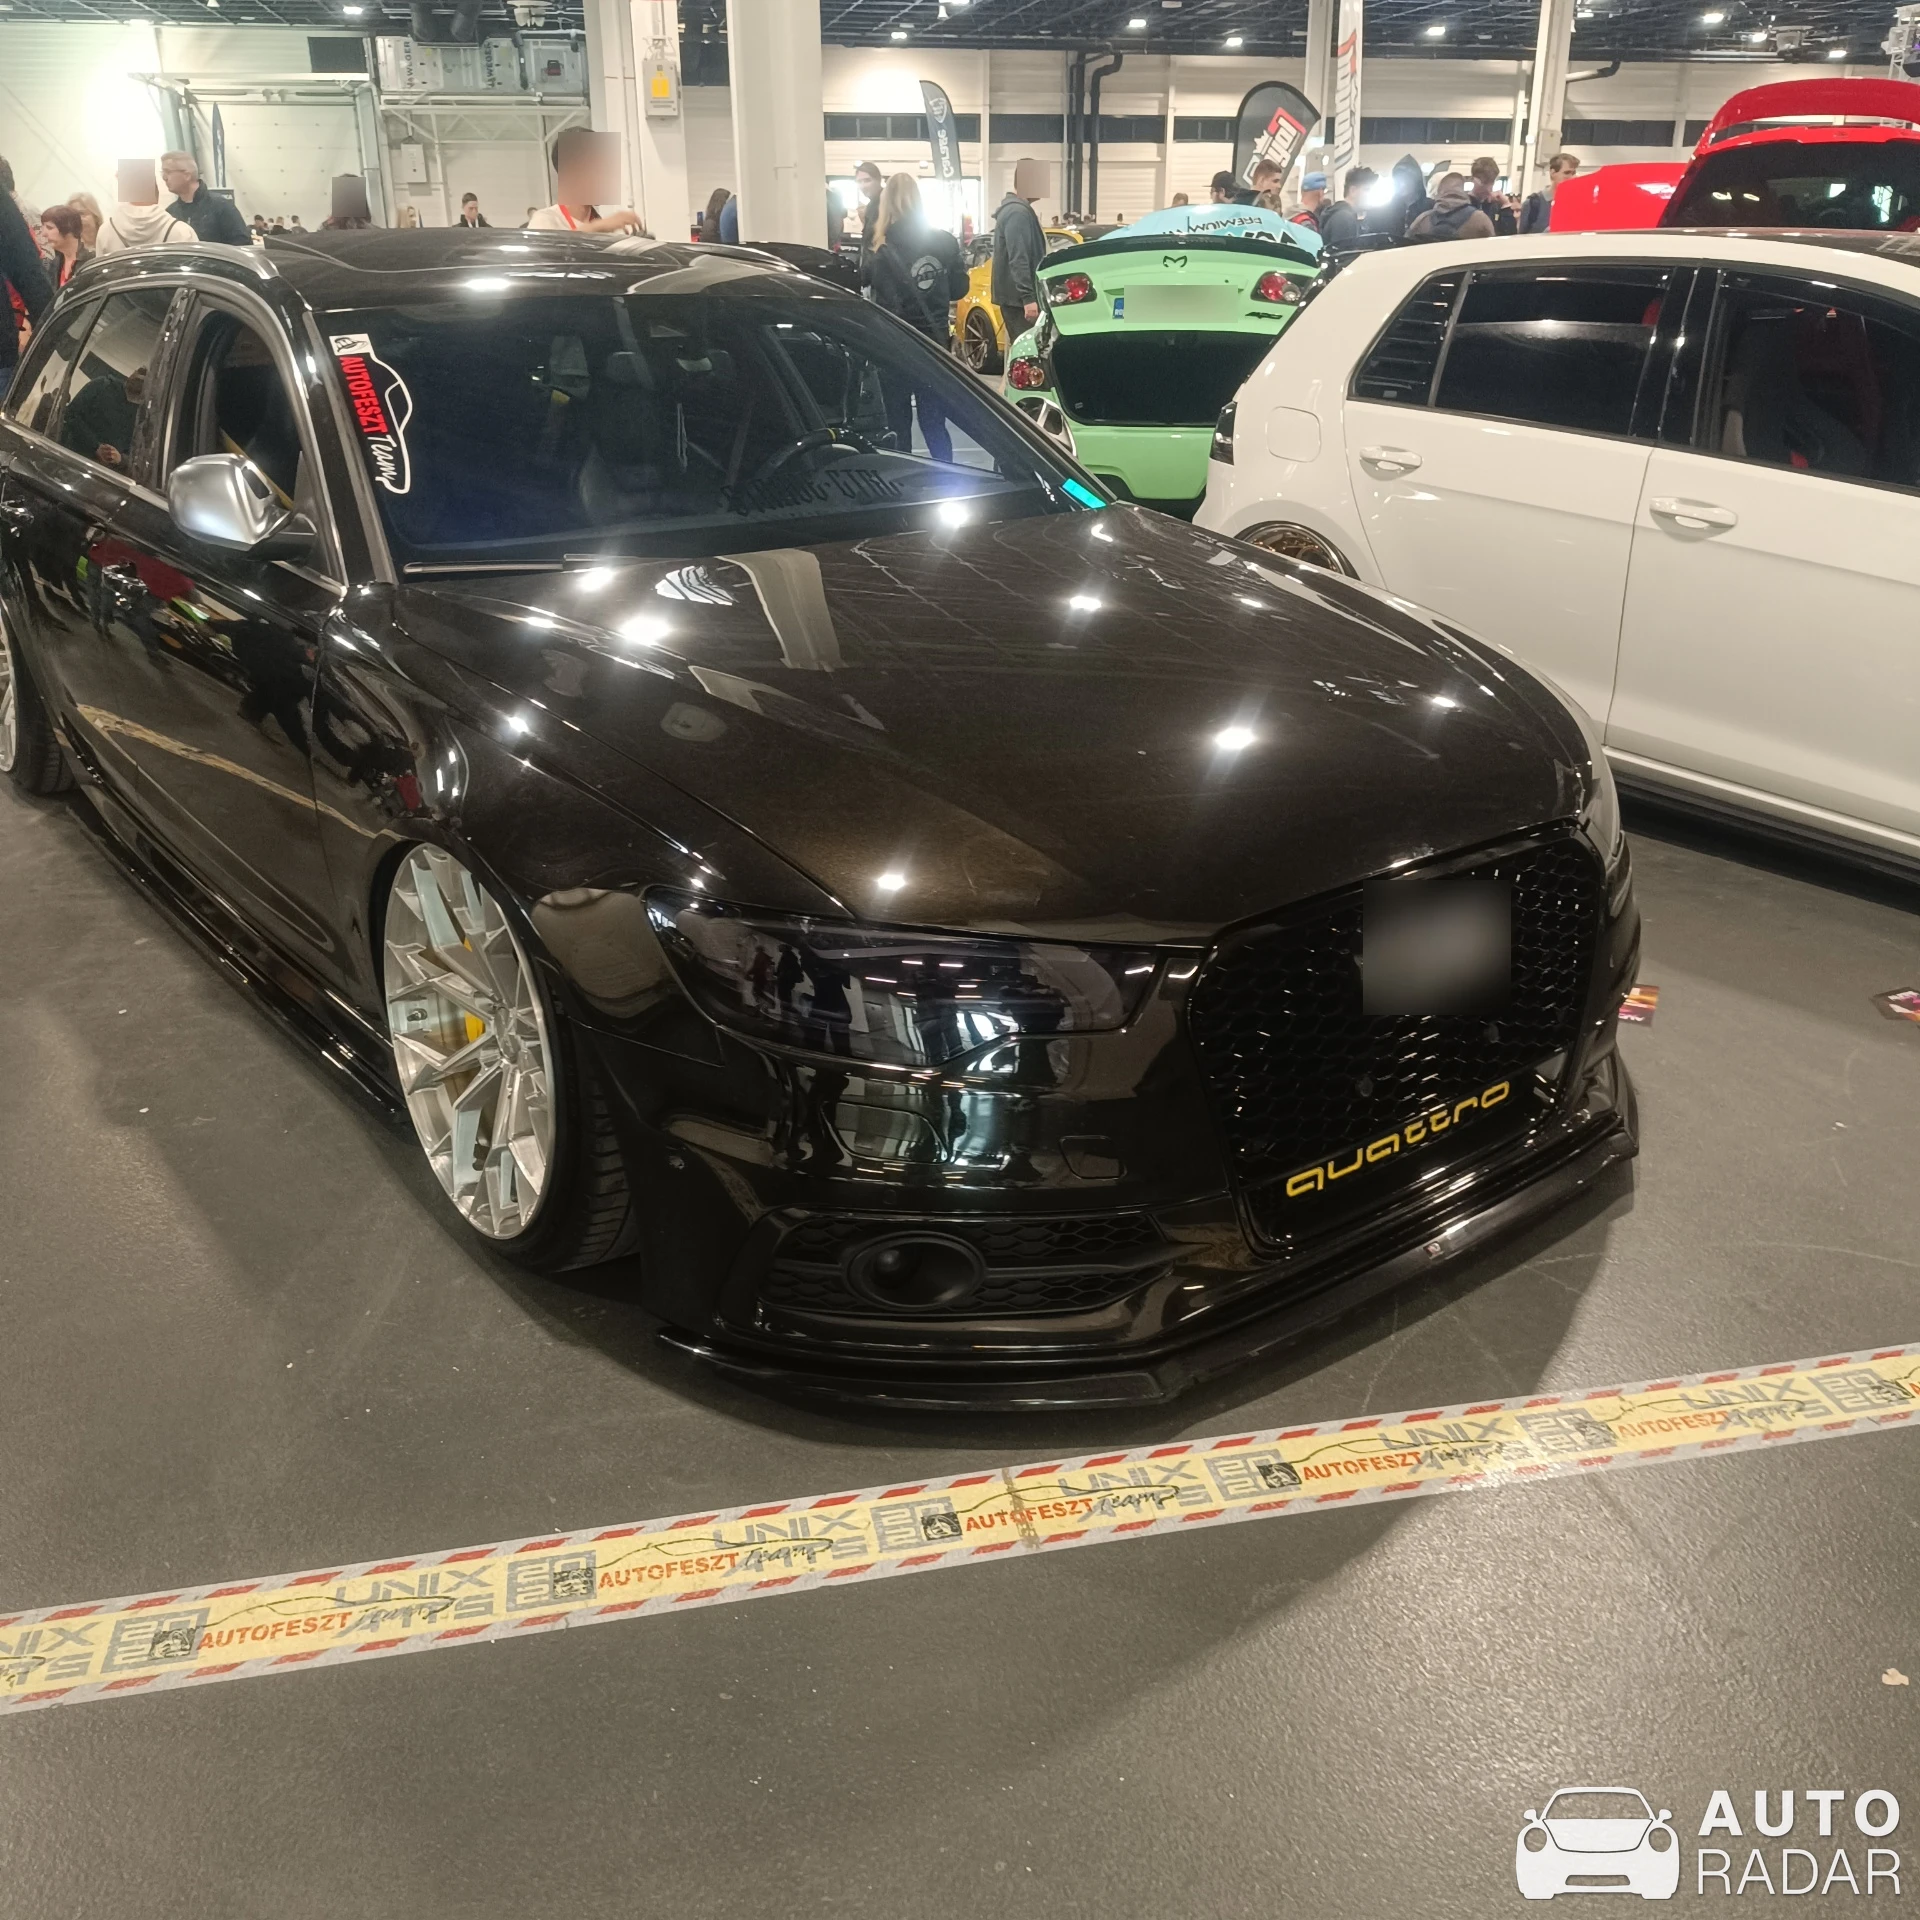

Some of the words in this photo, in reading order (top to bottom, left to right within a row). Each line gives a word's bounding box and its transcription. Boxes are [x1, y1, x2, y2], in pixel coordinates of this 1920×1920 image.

[339, 355, 389, 435] AUTOFESZT
[367, 434, 397, 482] Team
[1286, 1081, 1510, 1197] quattro
[1679, 1378, 1810, 1410] UNIX
[1378, 1417, 1517, 1449] UNIX
[1618, 1410, 1730, 1438] AUTOFESZT
[1058, 1460, 1198, 1497] UNIX
[1302, 1452, 1424, 1482] AUTOFESZT
[713, 1508, 862, 1549] UNIX
[966, 1498, 1095, 1532] AUTOFESZT
[334, 1564, 496, 1608] UNIX
[598, 1552, 740, 1590] AUTOFESZT
[0, 1620, 104, 1657] NIX
[197, 1611, 354, 1650] AUTOFESZT
